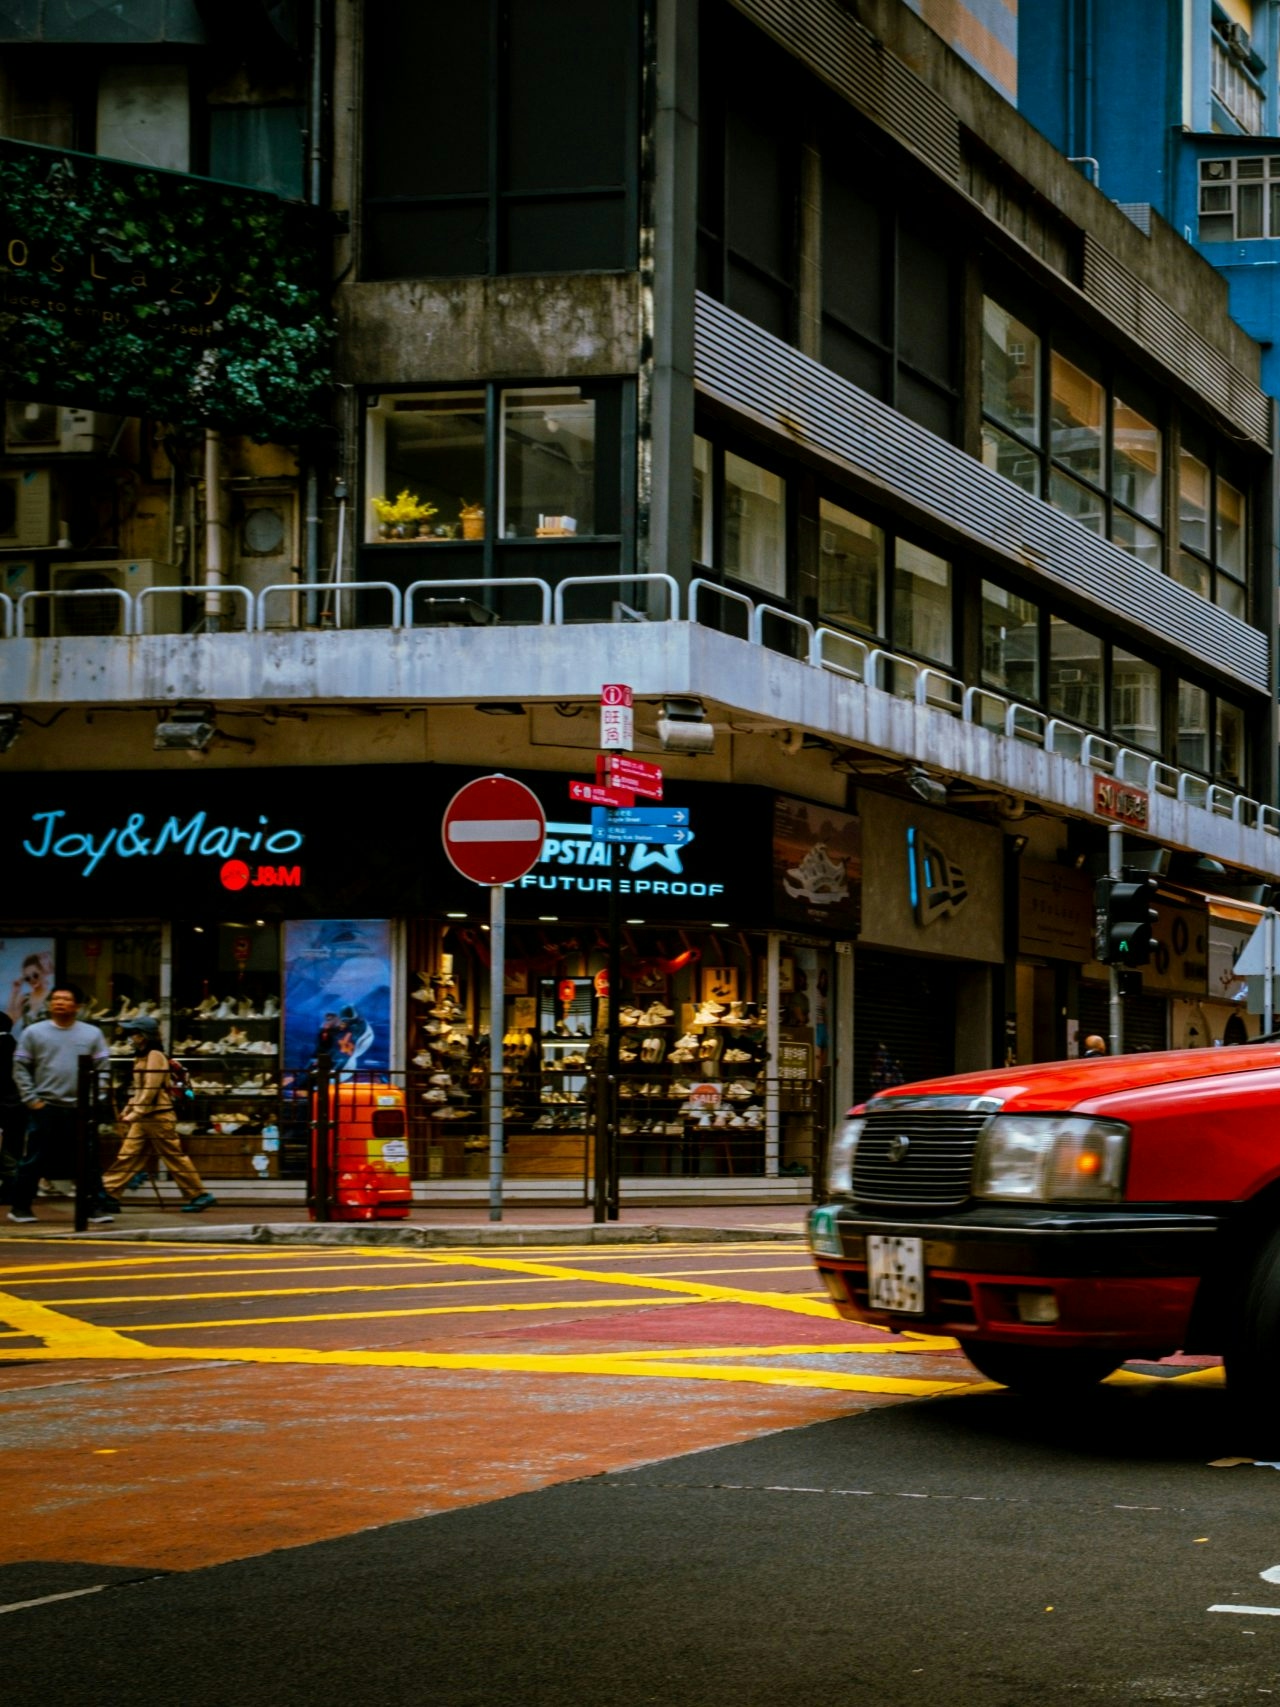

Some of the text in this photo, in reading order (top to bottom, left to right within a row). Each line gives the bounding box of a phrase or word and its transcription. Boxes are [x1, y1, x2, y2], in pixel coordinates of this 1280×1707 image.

[604, 709, 621, 744] 旺角
[22, 810, 304, 878] Joy&Mario
[250, 866, 302, 887] J&M
